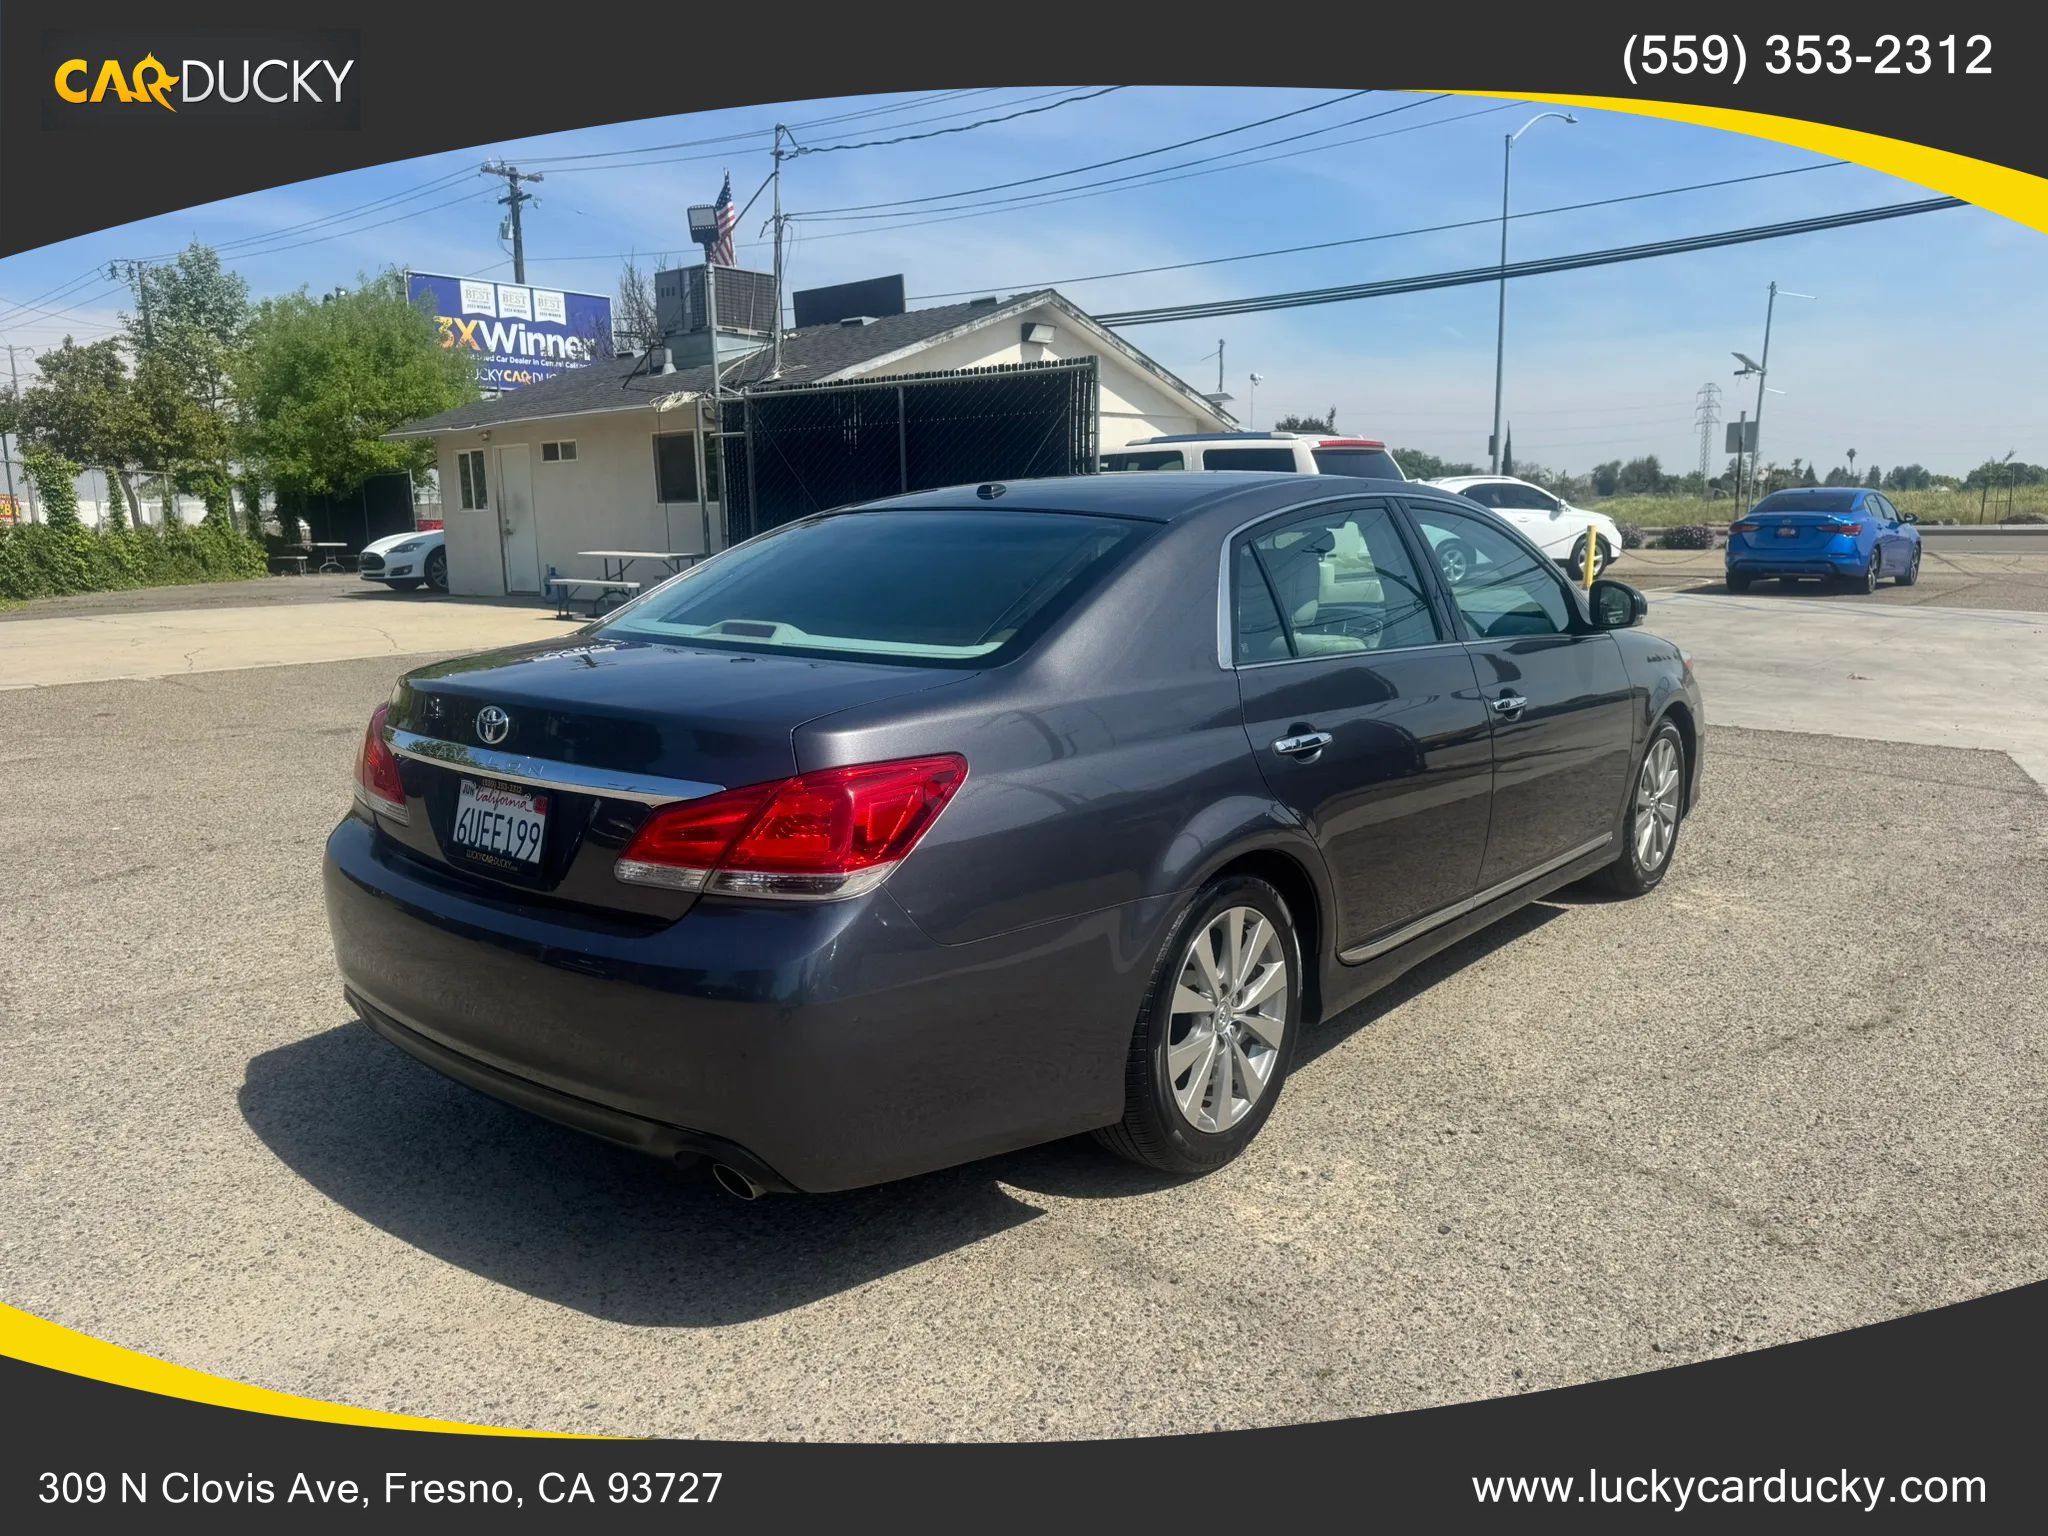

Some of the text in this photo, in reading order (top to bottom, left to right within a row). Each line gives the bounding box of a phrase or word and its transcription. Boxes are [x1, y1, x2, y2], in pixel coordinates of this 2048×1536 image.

[464, 288, 491, 301] BEST
[502, 293, 527, 305] BEST
[537, 297, 562, 309] BEST
[495, 354, 508, 363] Car
[509, 356, 532, 365] Dealer
[436, 745, 545, 777] AVLON
[475, 785, 533, 812] California
